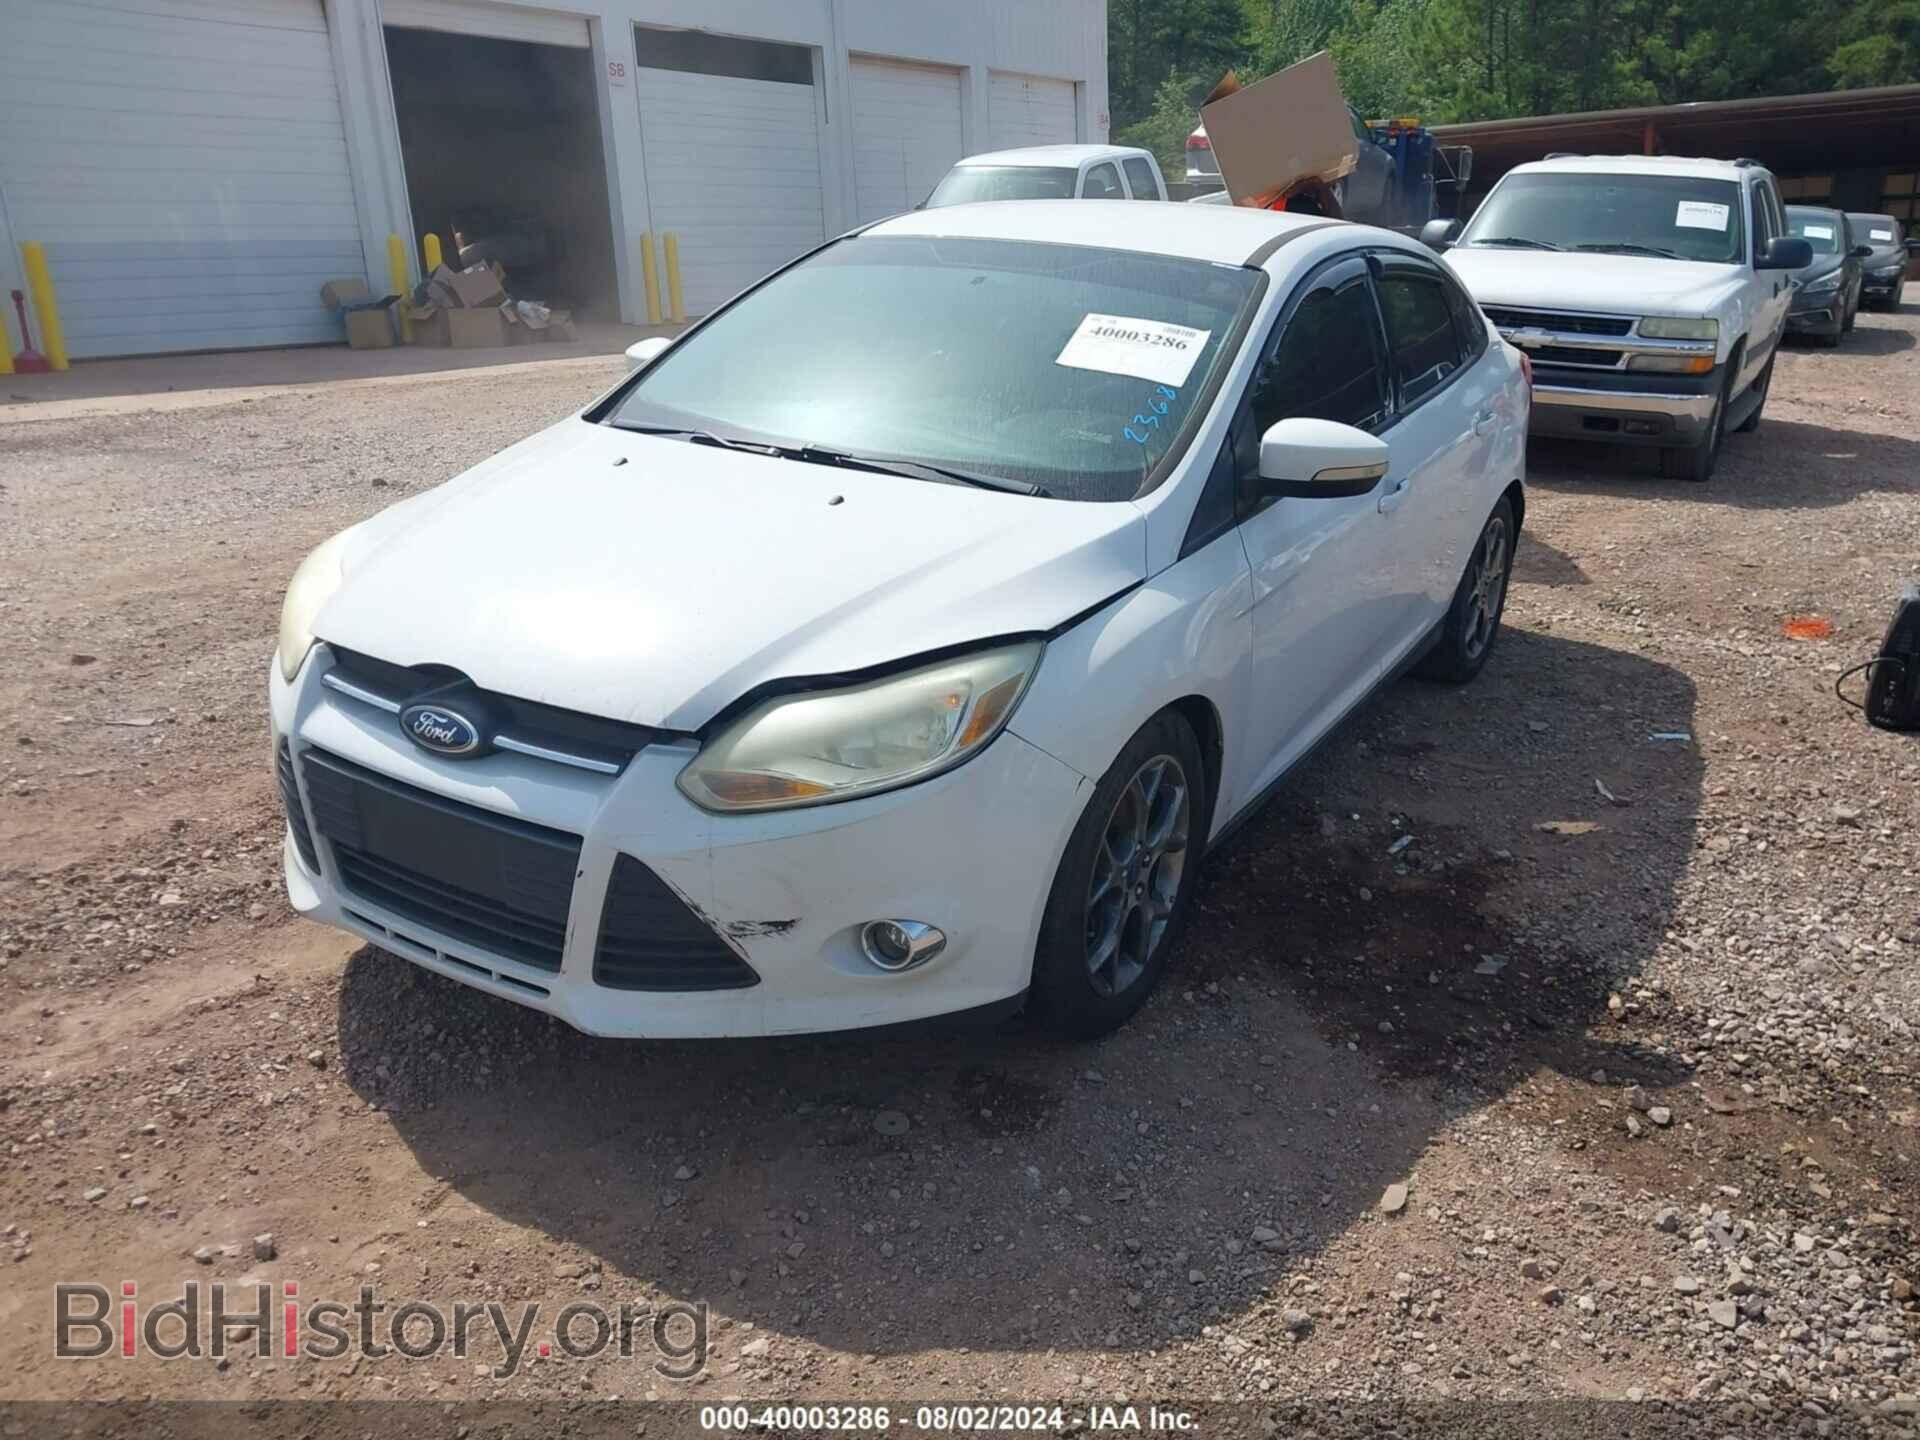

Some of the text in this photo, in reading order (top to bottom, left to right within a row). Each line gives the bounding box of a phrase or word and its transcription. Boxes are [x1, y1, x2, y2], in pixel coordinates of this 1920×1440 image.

[1089, 325, 1188, 351] 40003286
[1123, 384, 1177, 443] 2368
[413, 711, 458, 744] Ford
